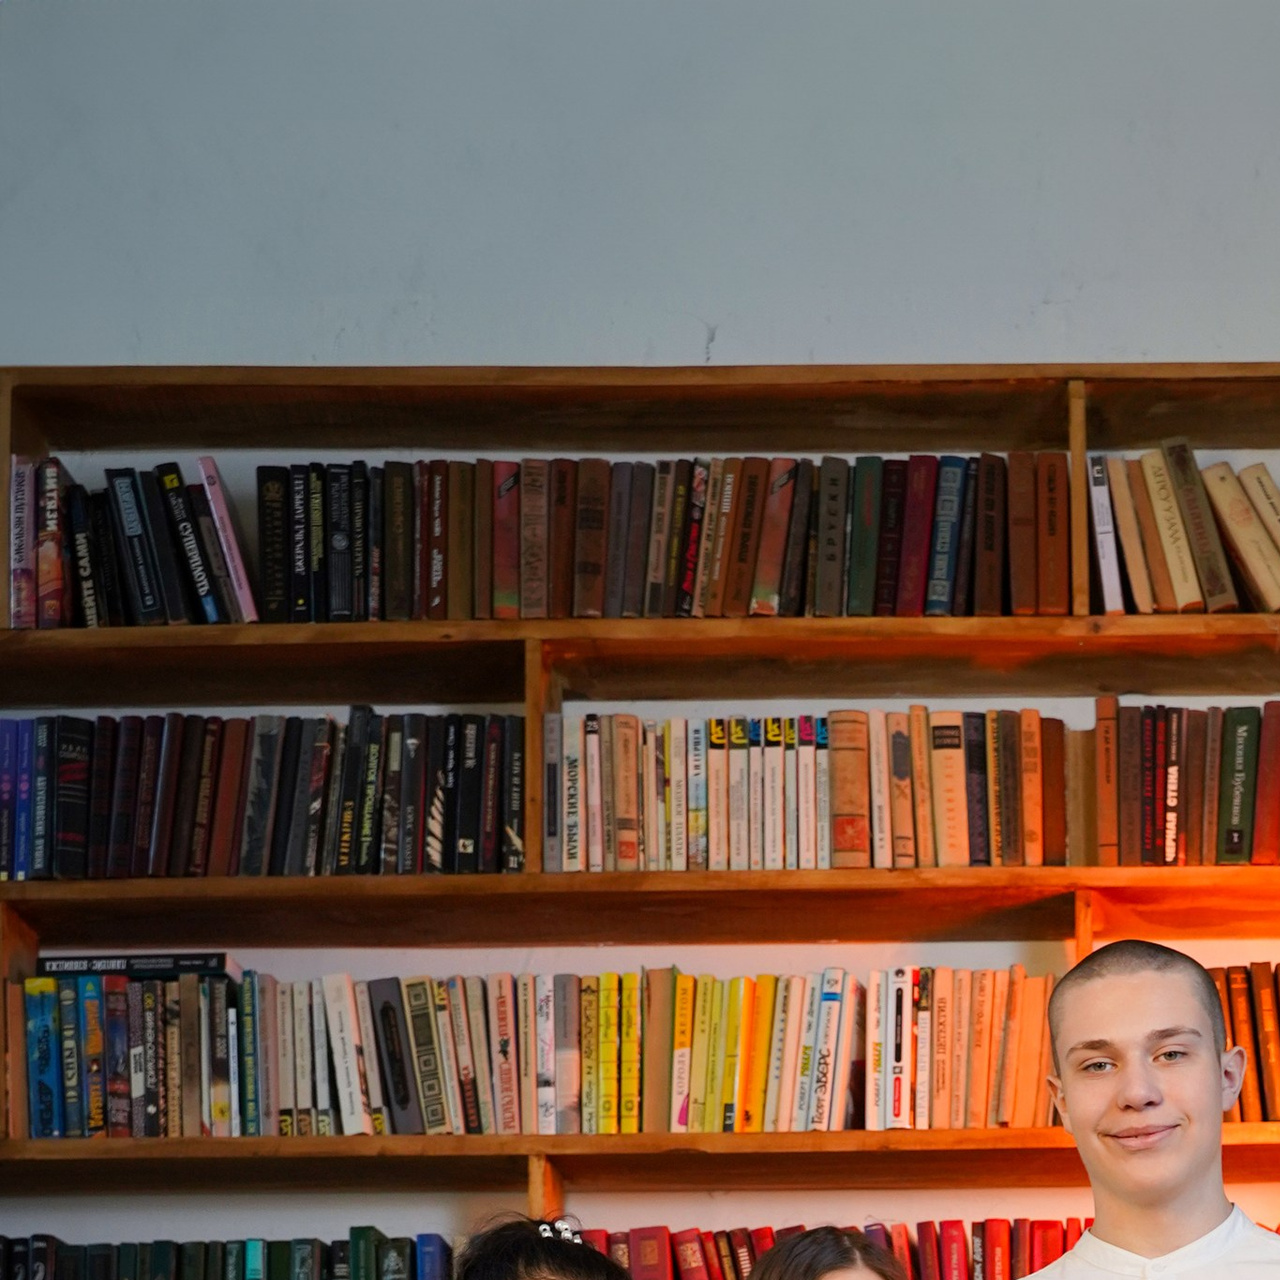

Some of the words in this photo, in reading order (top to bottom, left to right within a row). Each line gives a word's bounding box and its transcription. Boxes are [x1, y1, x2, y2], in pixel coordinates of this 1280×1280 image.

[825, 476, 839, 563] БРУСКИ
[75, 532, 93, 577] САМИ
[1165, 765, 1179, 807] СТЕНА
[1165, 811, 1179, 862] ЧЕРНАЯ
[678, 988, 689, 1038] ЖЕЛТОМ
[936, 997, 947, 1055] ДЕТЕКТИВ
[675, 1053, 687, 1097] КОРОЛЬ
[815, 1048, 831, 1096] ЭБЕРС
